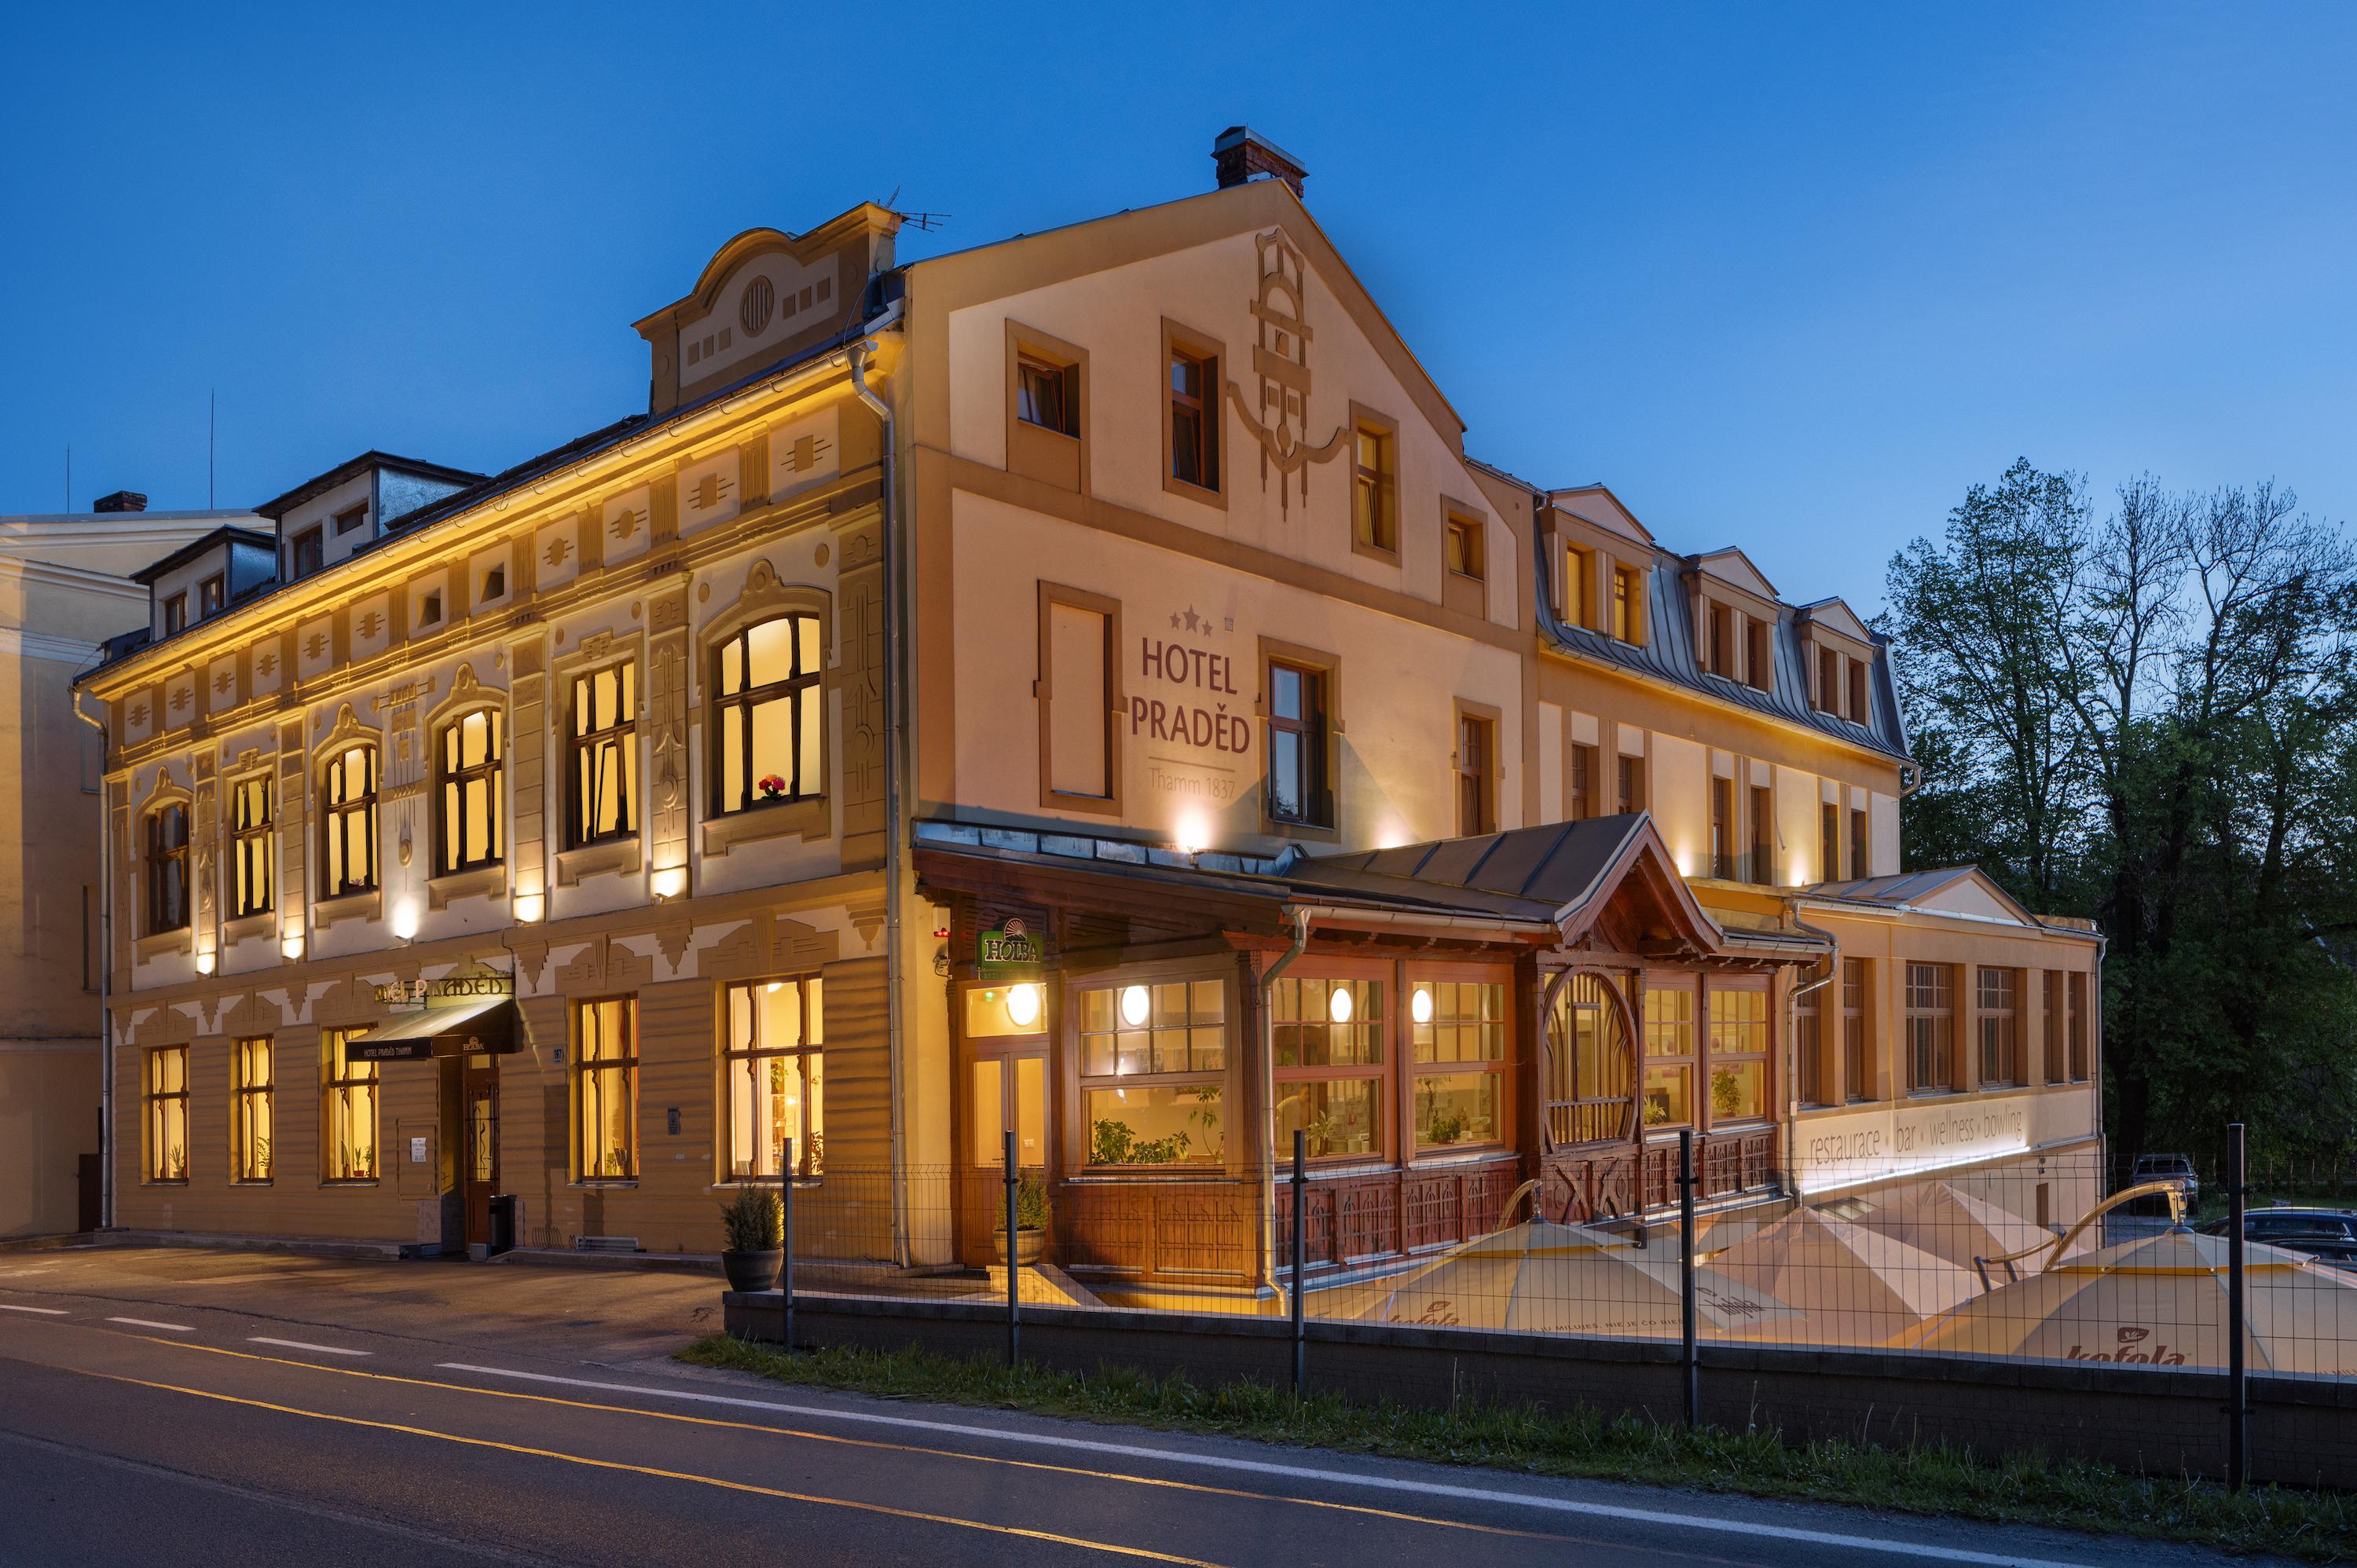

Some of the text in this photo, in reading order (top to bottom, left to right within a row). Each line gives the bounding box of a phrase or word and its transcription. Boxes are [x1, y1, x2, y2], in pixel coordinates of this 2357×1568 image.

[1142, 637, 1237, 695] HOTEL
[1131, 696, 1250, 754] PRADĚD
[1148, 767, 1235, 799] Thamm 1837
[984, 939, 1040, 963] HOLBA
[364, 1049, 378, 1057] HOTEL
[1809, 1103, 2022, 1167] restaurace bar wellness bowling
